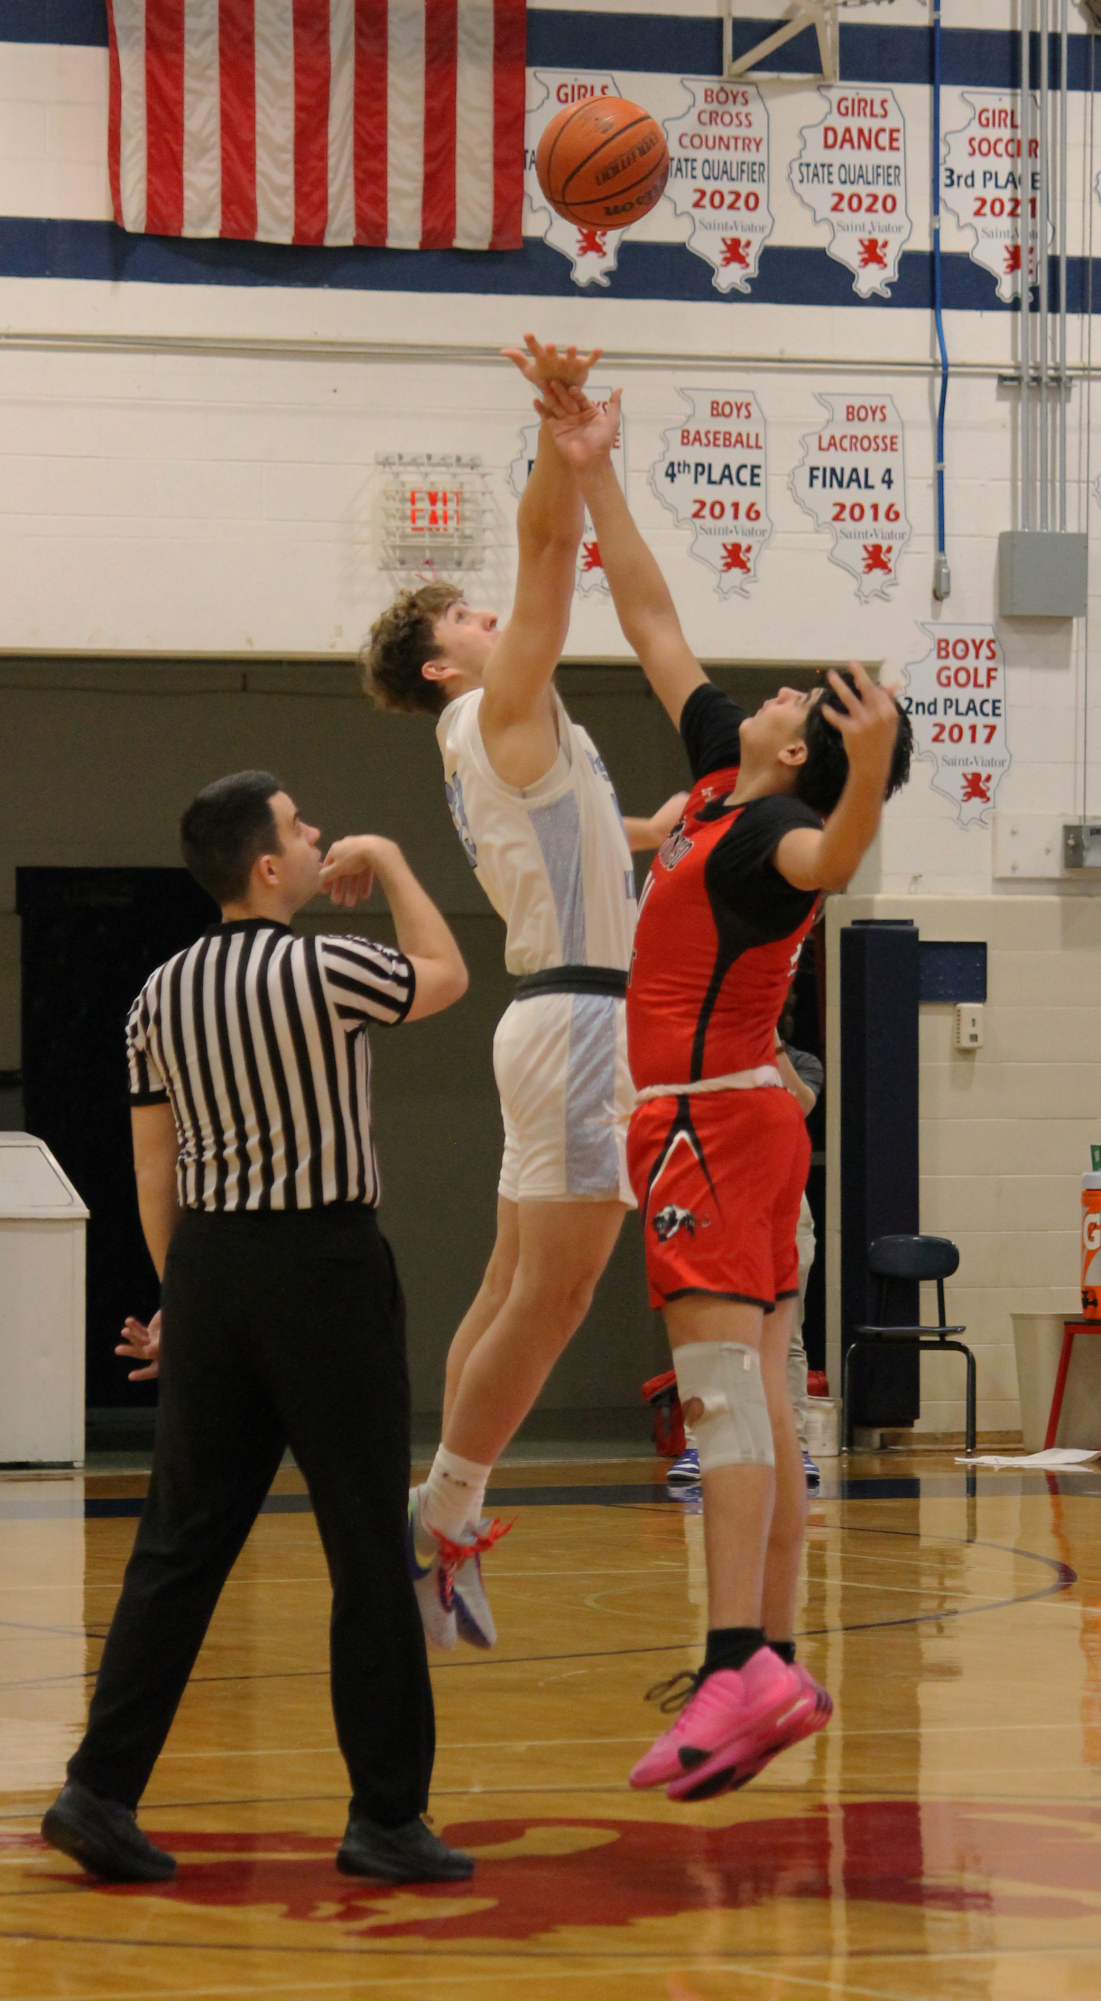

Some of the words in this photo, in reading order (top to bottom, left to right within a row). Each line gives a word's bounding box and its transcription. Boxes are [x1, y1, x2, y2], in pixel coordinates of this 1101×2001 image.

[704, 87, 749, 106] BOYS
[837, 97, 888, 119] GIRLS
[978, 108, 1019, 128] GIRL
[697, 110, 752, 128] CROSS
[679, 134, 763, 153] COUNTRY
[823, 127, 900, 150] DANCE
[669, 157, 698, 179] TATE
[702, 161, 765, 184] QUALIFIER
[798, 163, 833, 184] STATE
[839, 166, 901, 186] QUALIFIER
[944, 168, 975, 188] 3rd
[692, 188, 760, 211] 2020
[830, 193, 897, 213] 2020
[973, 196, 1036, 219] 2021
[711, 401, 751, 418] BOYS
[846, 405, 886, 421] BOYS
[681, 429, 763, 449] BASEBALL
[818, 434, 898, 452] LACROSSE
[694, 464, 761, 486] PLACE
[809, 467, 874, 488] FINAL
[881, 468, 893, 489] 4
[692, 500, 761, 520] 2016
[831, 503, 900, 521] 2016
[937, 639, 996, 660] BOYS
[936, 667, 998, 688] GOLF
[904, 697, 937, 715] 2nd
[944, 698, 1001, 717] PLACE
[931, 724, 996, 743] 2017
